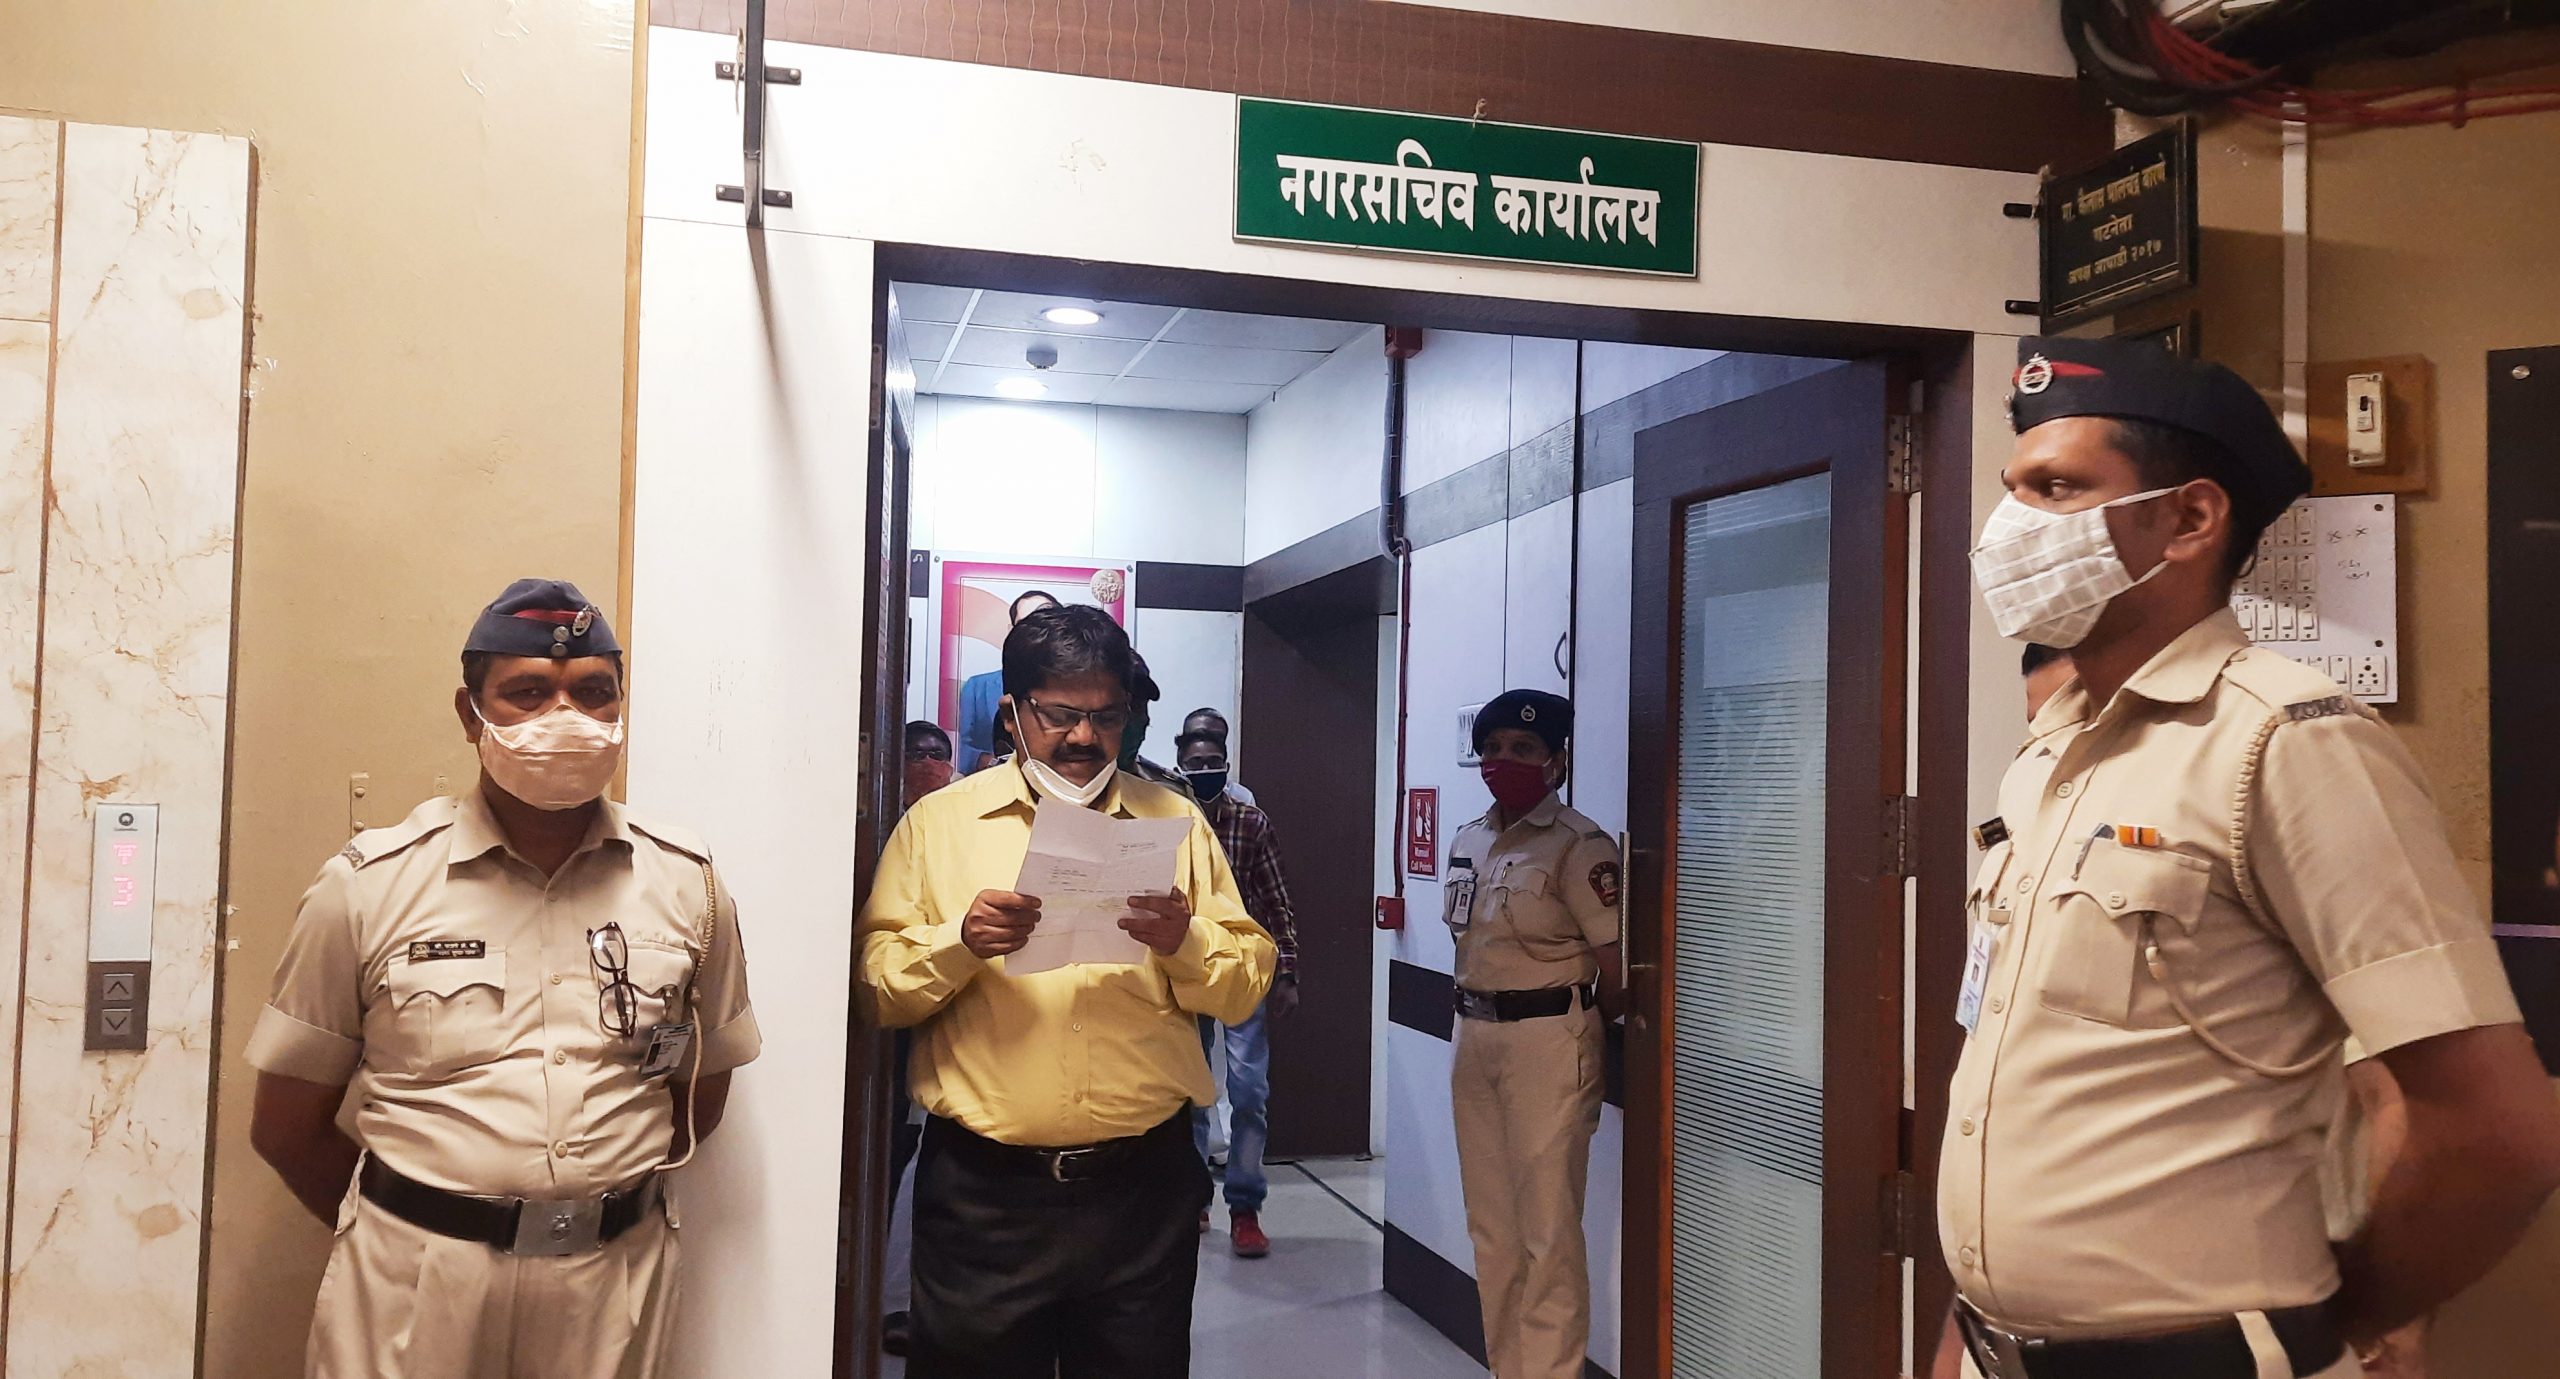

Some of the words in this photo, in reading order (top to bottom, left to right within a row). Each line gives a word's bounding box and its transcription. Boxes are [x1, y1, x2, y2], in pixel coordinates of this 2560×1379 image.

[1276, 138, 1479, 232] नगरसचिव
[1491, 156, 1661, 248] कार्यालय
[2093, 213, 2134, 242] गटनेता
[112, 877, 133, 906] 3
